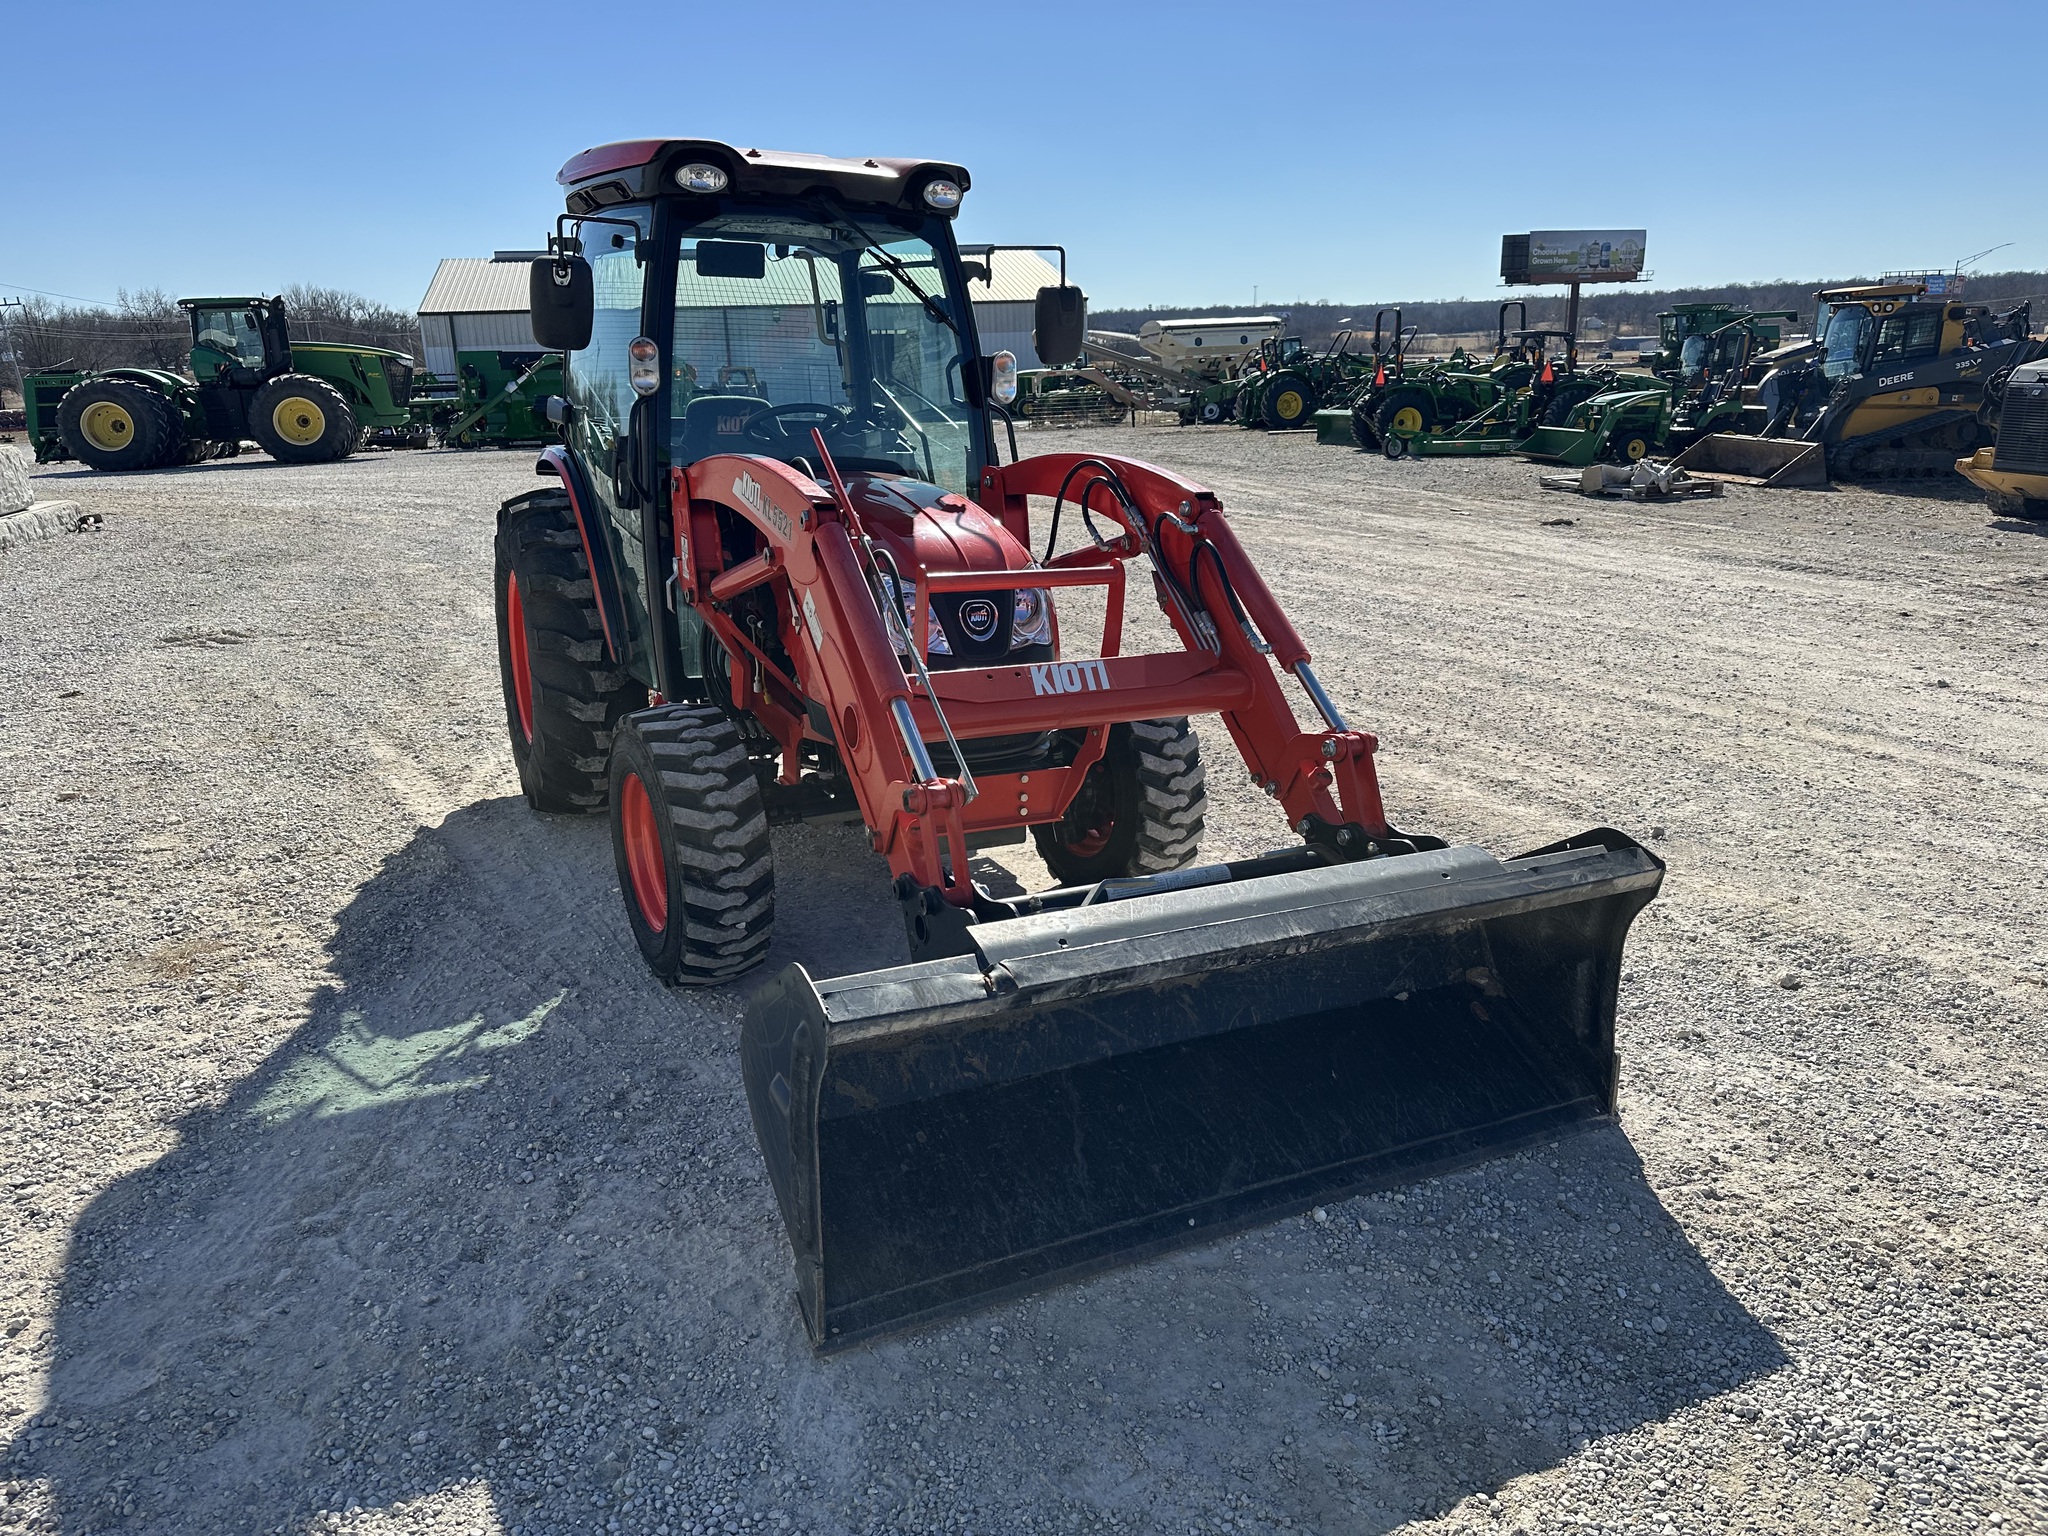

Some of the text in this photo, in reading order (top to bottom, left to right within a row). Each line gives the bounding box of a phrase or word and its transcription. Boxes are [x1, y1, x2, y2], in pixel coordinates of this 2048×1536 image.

[1532, 248, 1557, 256] Choose
[1553, 256, 1568, 264] Here
[1878, 371, 1914, 388] DEERE
[742, 470, 761, 511] KIOTI
[1030, 660, 1111, 696] KIOTI
